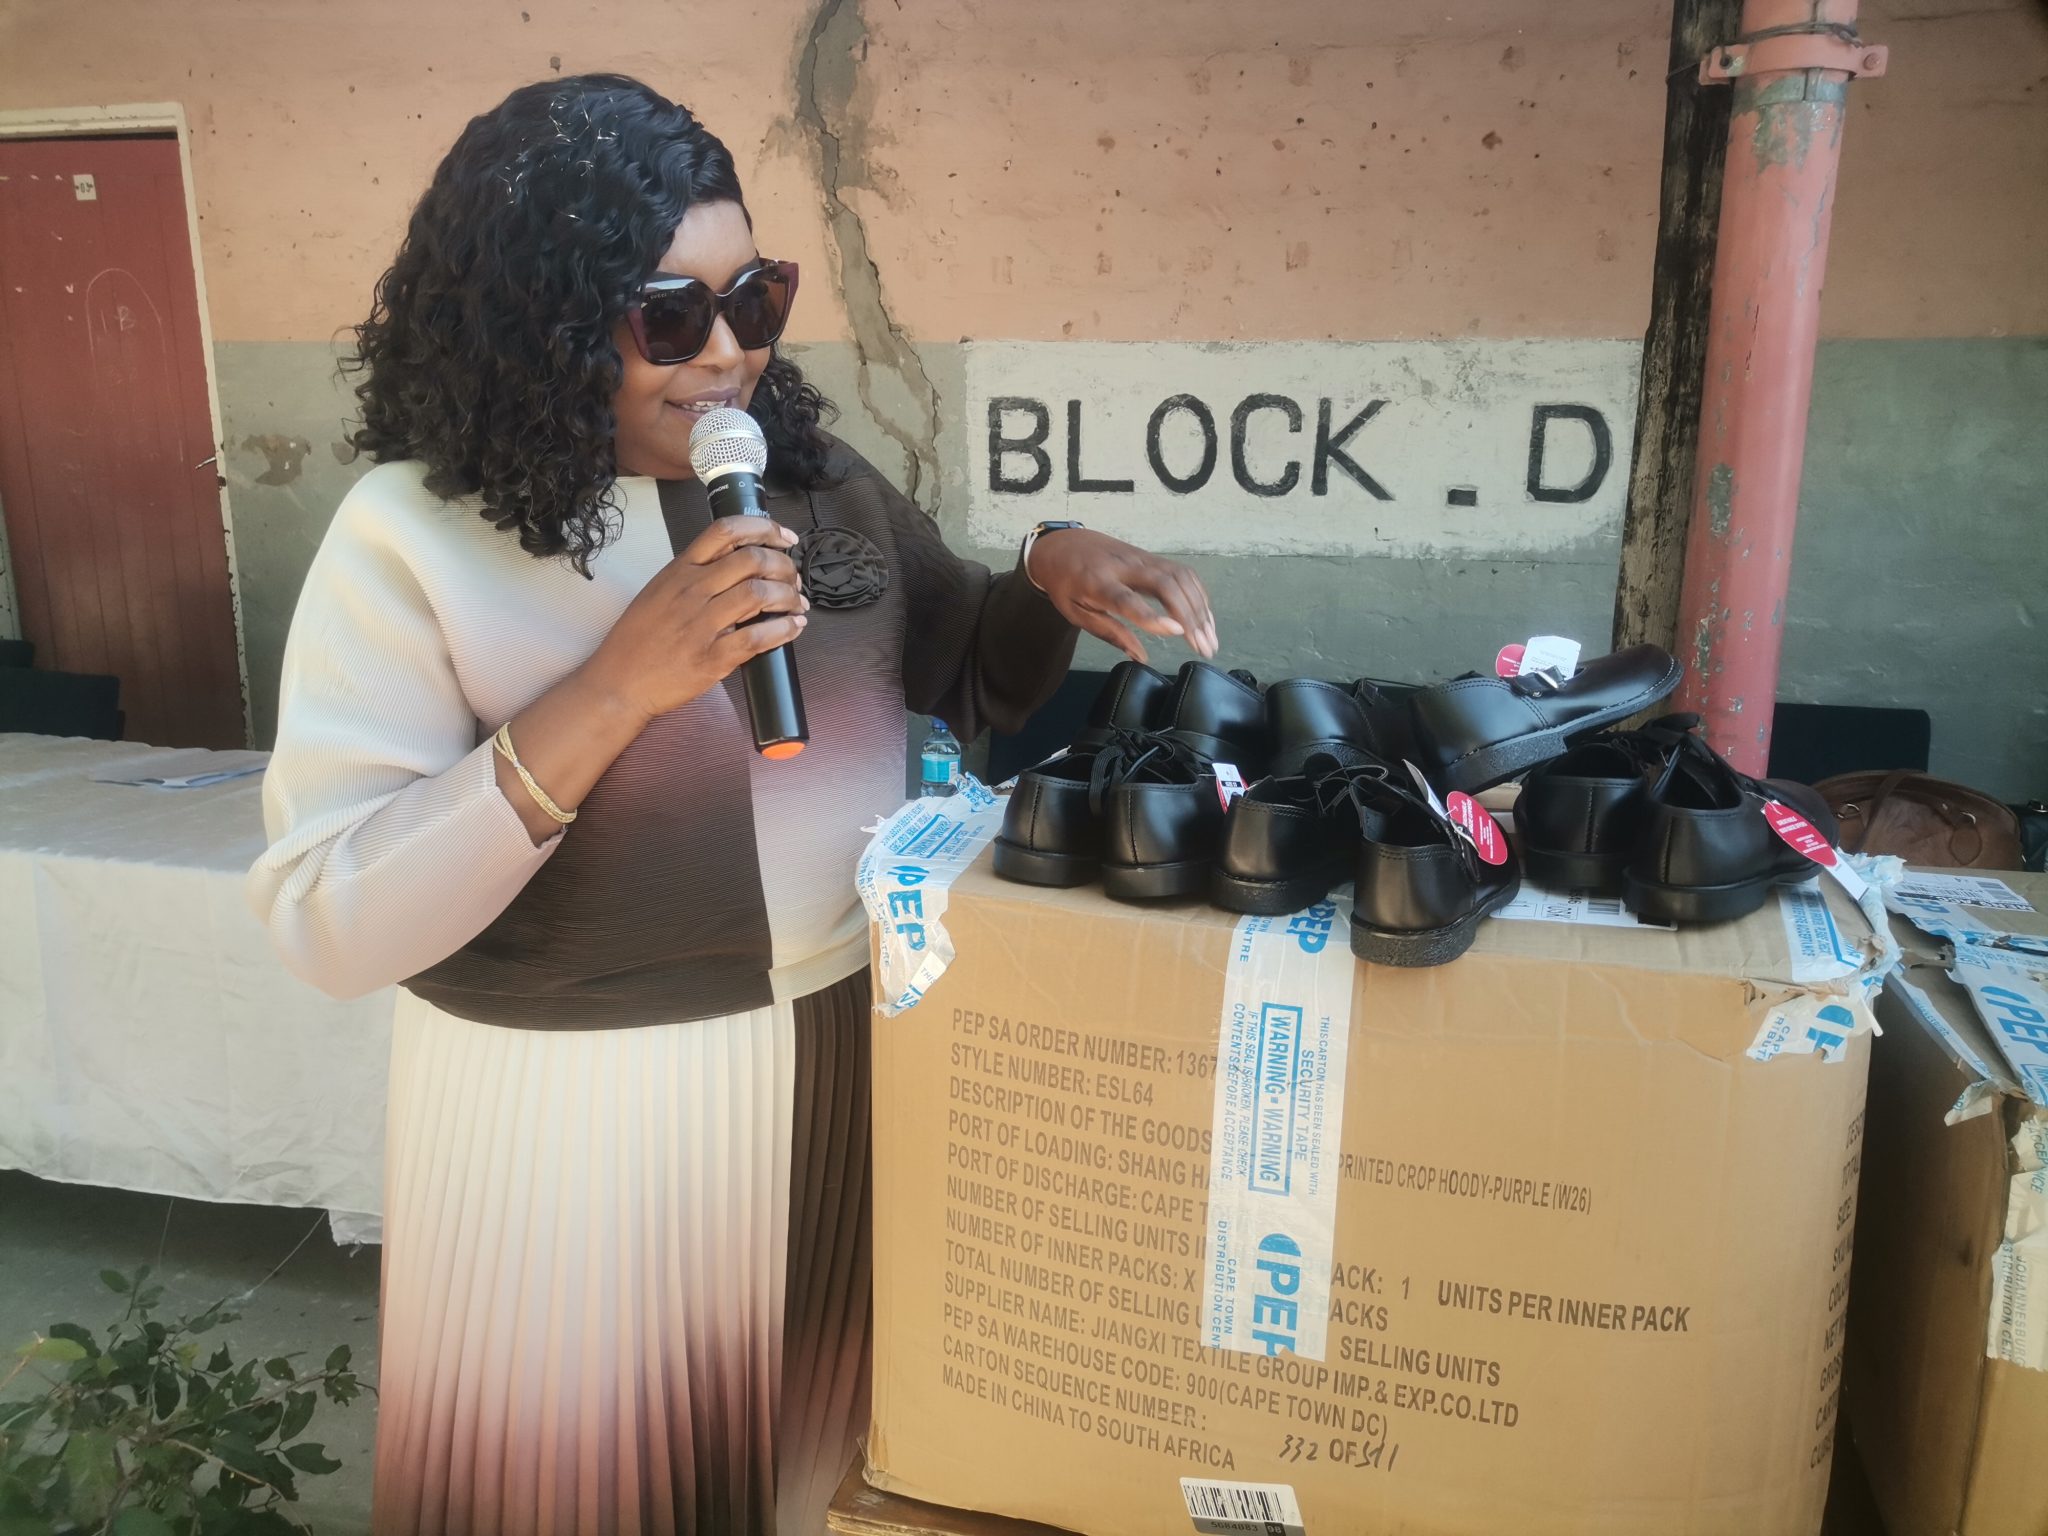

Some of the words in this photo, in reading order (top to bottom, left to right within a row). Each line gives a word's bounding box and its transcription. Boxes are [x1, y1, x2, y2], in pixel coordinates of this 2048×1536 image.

[988, 392, 1395, 502] BLOCK
[1527, 403, 1613, 503] D
[887, 871, 926, 951] PEP
[1286, 907, 1337, 953] PEP
[1240, 923, 1256, 963] CENTRE
[952, 1008, 985, 1036] PEP
[988, 1015, 1012, 1043] SA
[1015, 1021, 1079, 1057] ORDER
[1083, 1034, 1172, 1074] NUMBER:
[1229, 1003, 1245, 1063] CONTENTS
[1246, 1021, 1257, 1041] THIS
[1248, 1010, 1259, 1020] IF
[1320, 1017, 1329, 1039] THIS
[951, 1042, 1003, 1077] STYLE
[1008, 1055, 1090, 1096] NUMBER:
[1096, 1073, 1153, 1107] ESL64
[1244, 1042, 1256, 1063] SEAL
[1265, 1016, 1292, 1095] WARNING
[1316, 1040, 1328, 1081] CARTON
[1226, 1064, 1240, 1108] BEFORE
[1297, 1049, 1315, 1120] SECURITY
[1315, 1082, 1325, 1103] HAS
[949, 1109, 993, 1142] PORT
[997, 1123, 1020, 1148] OF
[1025, 1129, 1112, 1171] LOADING:
[1118, 1150, 1186, 1186] SHANG
[950, 1076, 1065, 1127] DESCRIPTION
[1070, 1105, 1096, 1132] OF
[1100, 1110, 1137, 1140] THE
[1142, 1119, 1213, 1155] GOODS
[1397, 1163, 1436, 1191] CROP
[1439, 1169, 1550, 1207] HOODY-PURPLE
[1553, 1181, 1592, 1215] (W26)
[1221, 1109, 1236, 1181] ACCEPTANCE
[1237, 1114, 1250, 1148] PLEASE
[1259, 1108, 1284, 1183] WARNING
[1294, 1126, 1309, 1161] TAPE
[1312, 1104, 1324, 1131] BEEN
[1235, 1149, 1248, 1177] CHECK
[1310, 1132, 1321, 1169] SEALED
[949, 1142, 992, 1175] PORT
[996, 1155, 1019, 1181] OF
[1023, 1161, 1137, 1210] DISCHARGE:
[1141, 1190, 1193, 1222] CAPE
[1308, 1171, 1319, 1196] WITH
[946, 1207, 1016, 1249] NUMBER
[1020, 1229, 1043, 1255] OF
[1048, 1237, 1103, 1272] INNER
[1108, 1251, 1178, 1289] PACKS:
[1183, 1268, 1196, 1293] X
[1329, 1298, 1388, 1331] ACKS
[947, 1174, 1017, 1216] NUMBER
[1022, 1196, 1045, 1223] OF
[1049, 1203, 1128, 1243] SELLING
[1133, 1220, 1190, 1257] UNITS
[1330, 1262, 1383, 1295] ACK:
[1401, 1276, 1410, 1300] 1
[1438, 1280, 1502, 1314] UNITS
[1508, 1291, 1552, 1322] PER
[1558, 1298, 1626, 1330] INNER
[1632, 1306, 1690, 1332] PACK
[1213, 1220, 1227, 1311] DISTRIBUTION
[1226, 1258, 1237, 1292] CAPE
[945, 1272, 1024, 1319] SUPPLIER
[1029, 1298, 1085, 1335] NAME:
[1090, 1315, 1166, 1356] JIANGXI
[1172, 1334, 1251, 1375] TEXTILE
[1256, 1355, 1329, 1390] GROUP
[946, 1239, 996, 1276] TOTAL
[1000, 1255, 1073, 1298] NUMBER
[1079, 1279, 1103, 1304] OF
[1108, 1285, 1189, 1325] SELLING
[1340, 1335, 1430, 1376] SELLING
[1436, 1353, 1501, 1387] UNITS
[1224, 1299, 1235, 1335] TOWN
[943, 1334, 1009, 1377] CARTON
[1014, 1358, 1110, 1406] SEQUENCE
[943, 1302, 973, 1332] PEP
[977, 1314, 999, 1341] SA
[1003, 1322, 1117, 1376] WAREHOUSE
[1121, 1357, 1181, 1392] CODE:
[1185, 1372, 1281, 1416] 900(CAPE
[1286, 1394, 1347, 1430] TOWN
[1351, 1408, 1388, 1441] DC)
[943, 1363, 987, 1399] MADE
[991, 1381, 1007, 1406] IN
[1011, 1390, 1065, 1426] CHINA
[1068, 1406, 1091, 1432] TO
[1096, 1414, 1160, 1452] SOUTH
[1163, 1441, 1236, 1471] AFRICA
[1279, 1434, 1318, 1463] 332
[1329, 1438, 1357, 1464] OF
